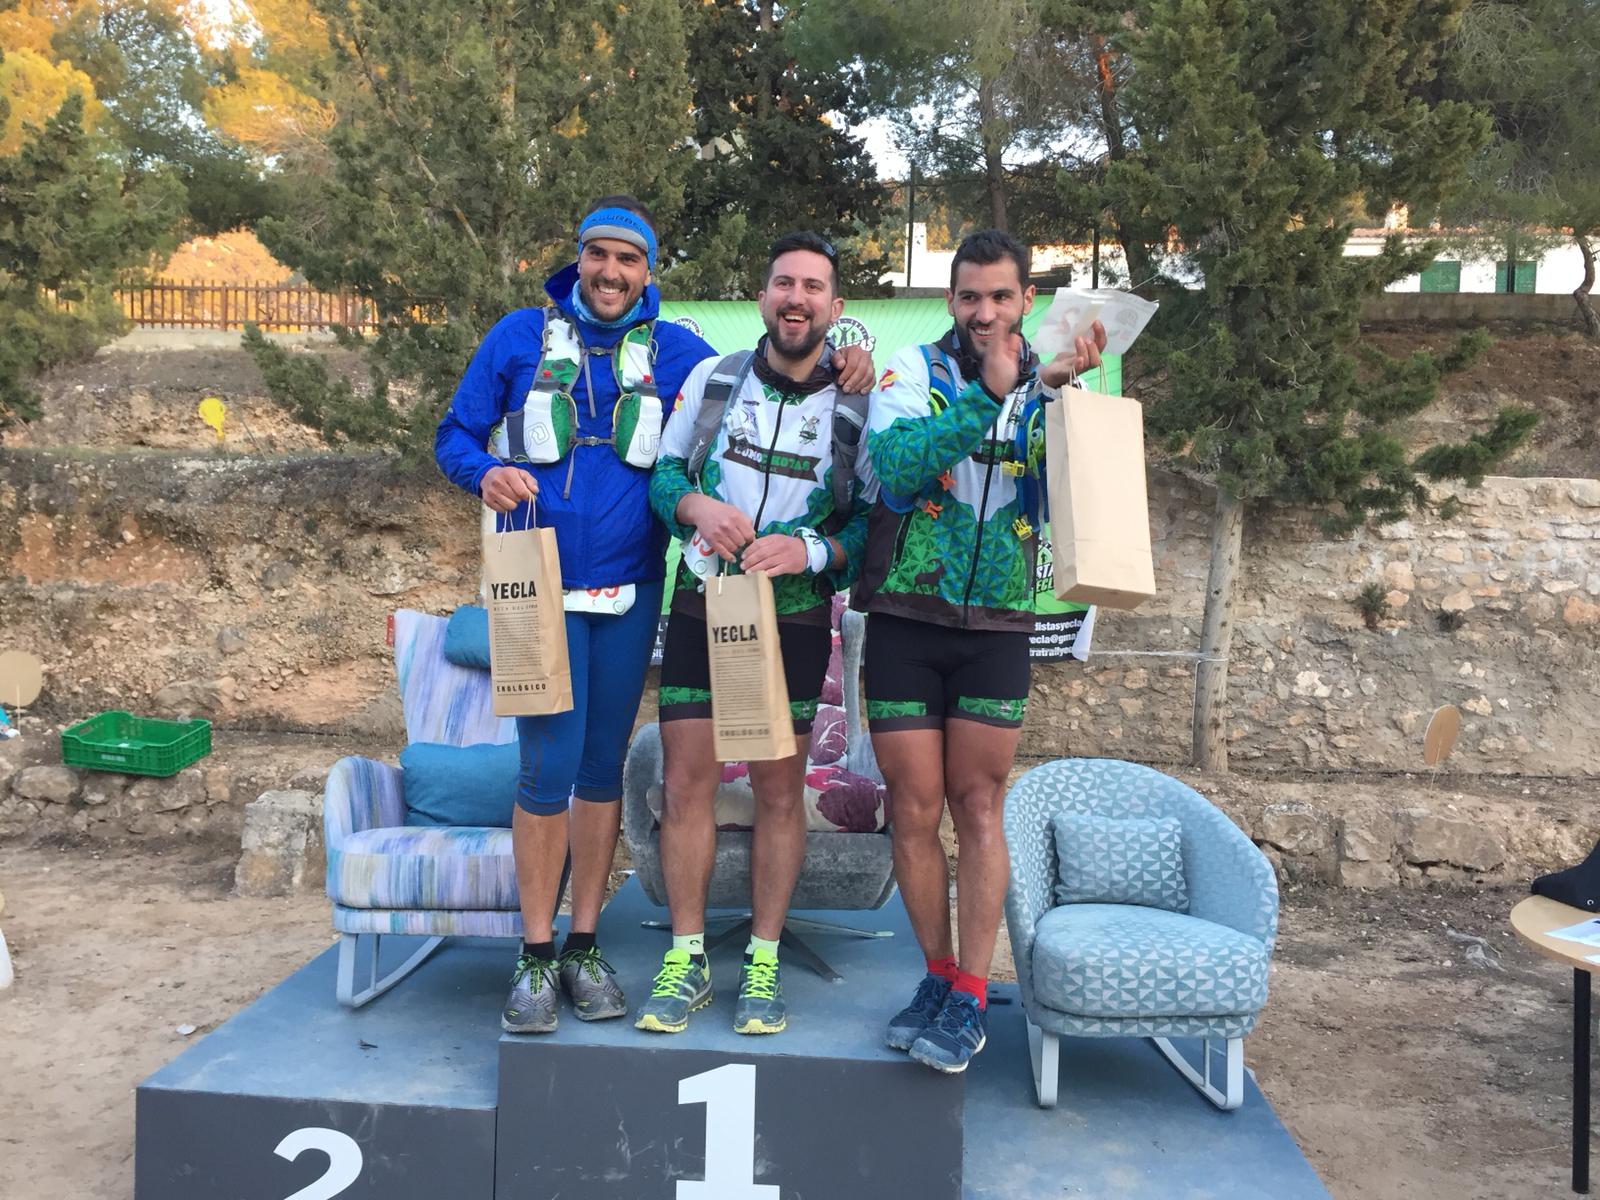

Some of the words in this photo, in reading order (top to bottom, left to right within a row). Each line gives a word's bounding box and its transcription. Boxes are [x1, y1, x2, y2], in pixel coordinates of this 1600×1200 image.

[491, 580, 537, 600] YECLA
[712, 624, 758, 644] YECLA
[676, 1063, 780, 1200] 1
[272, 1127, 364, 1200] 2
